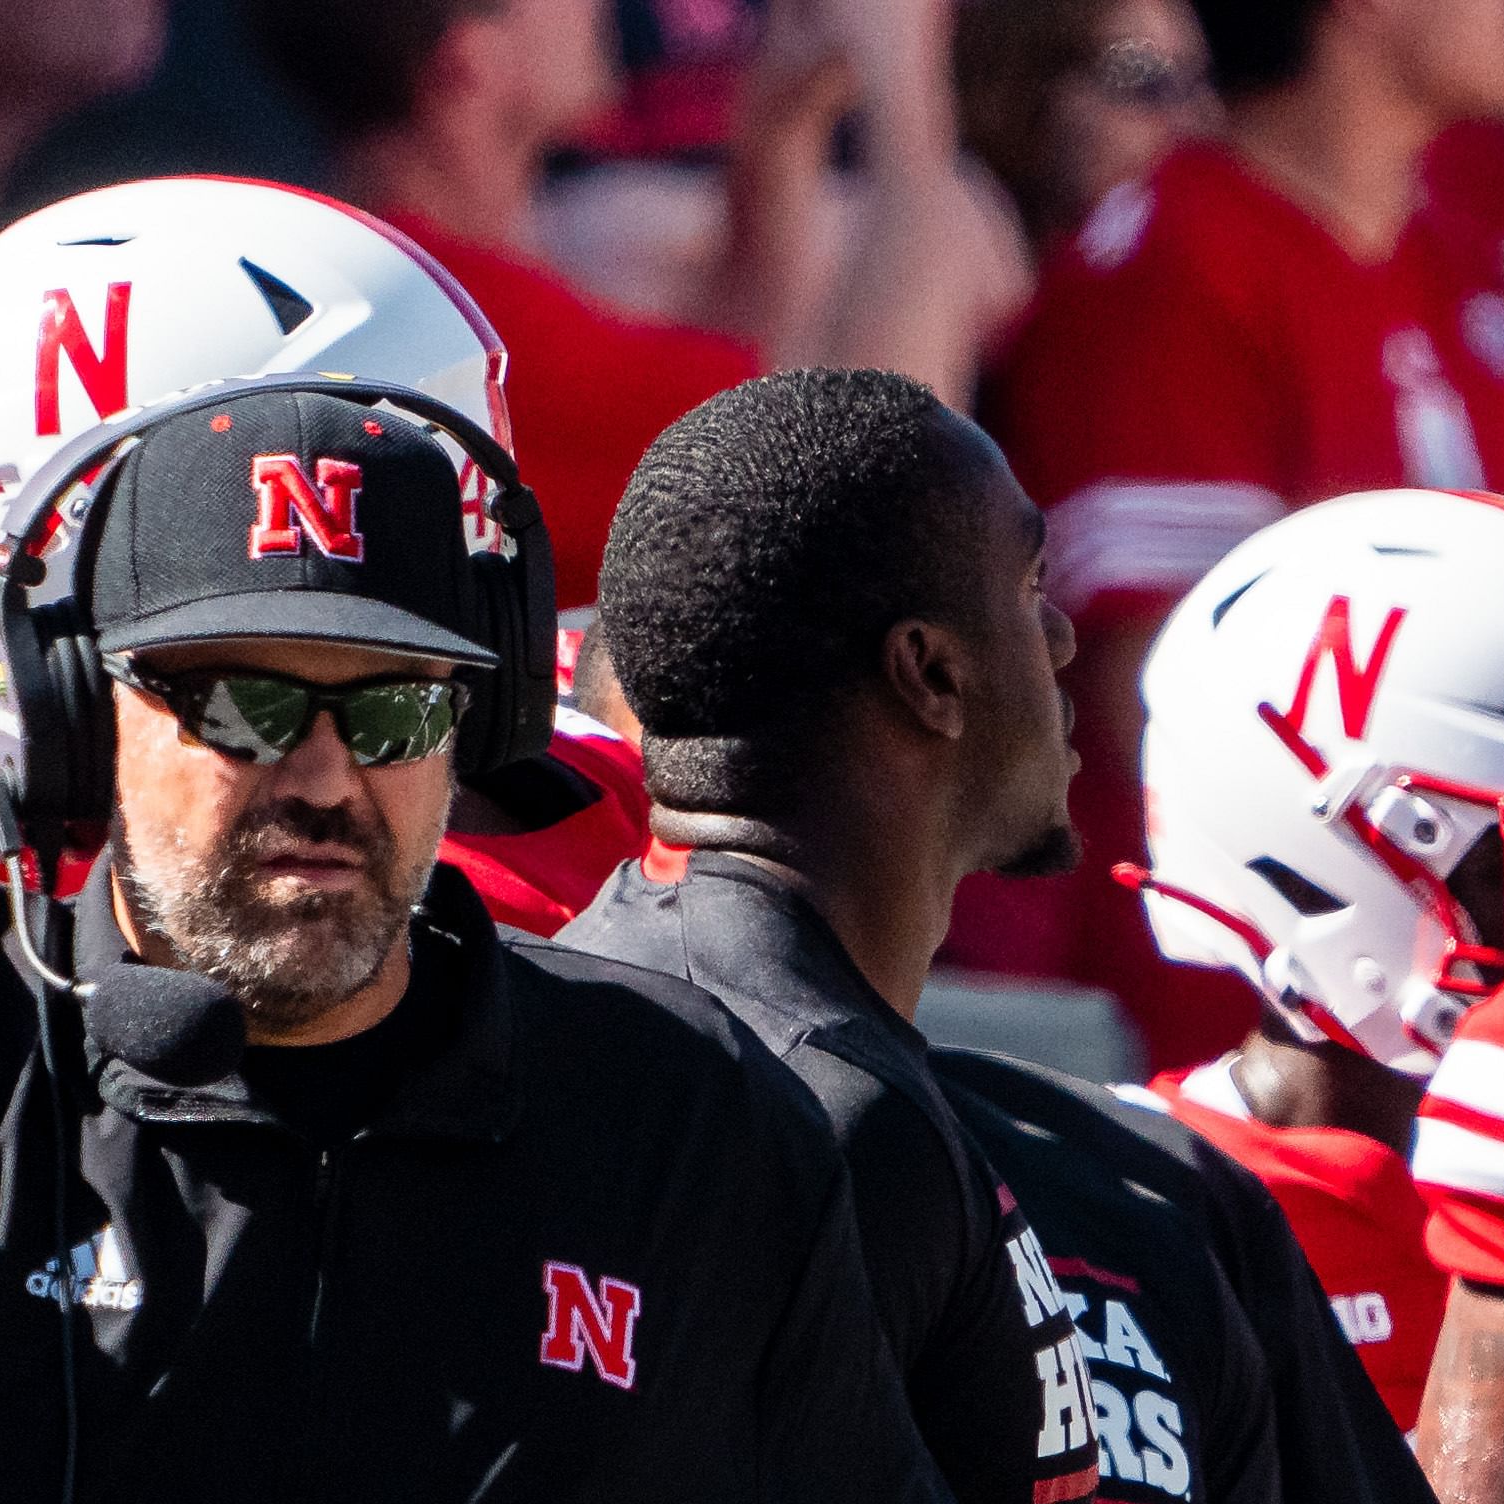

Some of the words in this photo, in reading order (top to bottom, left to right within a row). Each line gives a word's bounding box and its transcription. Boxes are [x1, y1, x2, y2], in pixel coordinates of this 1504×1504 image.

[35, 281, 132, 437] N
[249, 453, 364, 562] N
[1257, 594, 1409, 784] N
[540, 1260, 640, 1390] N
